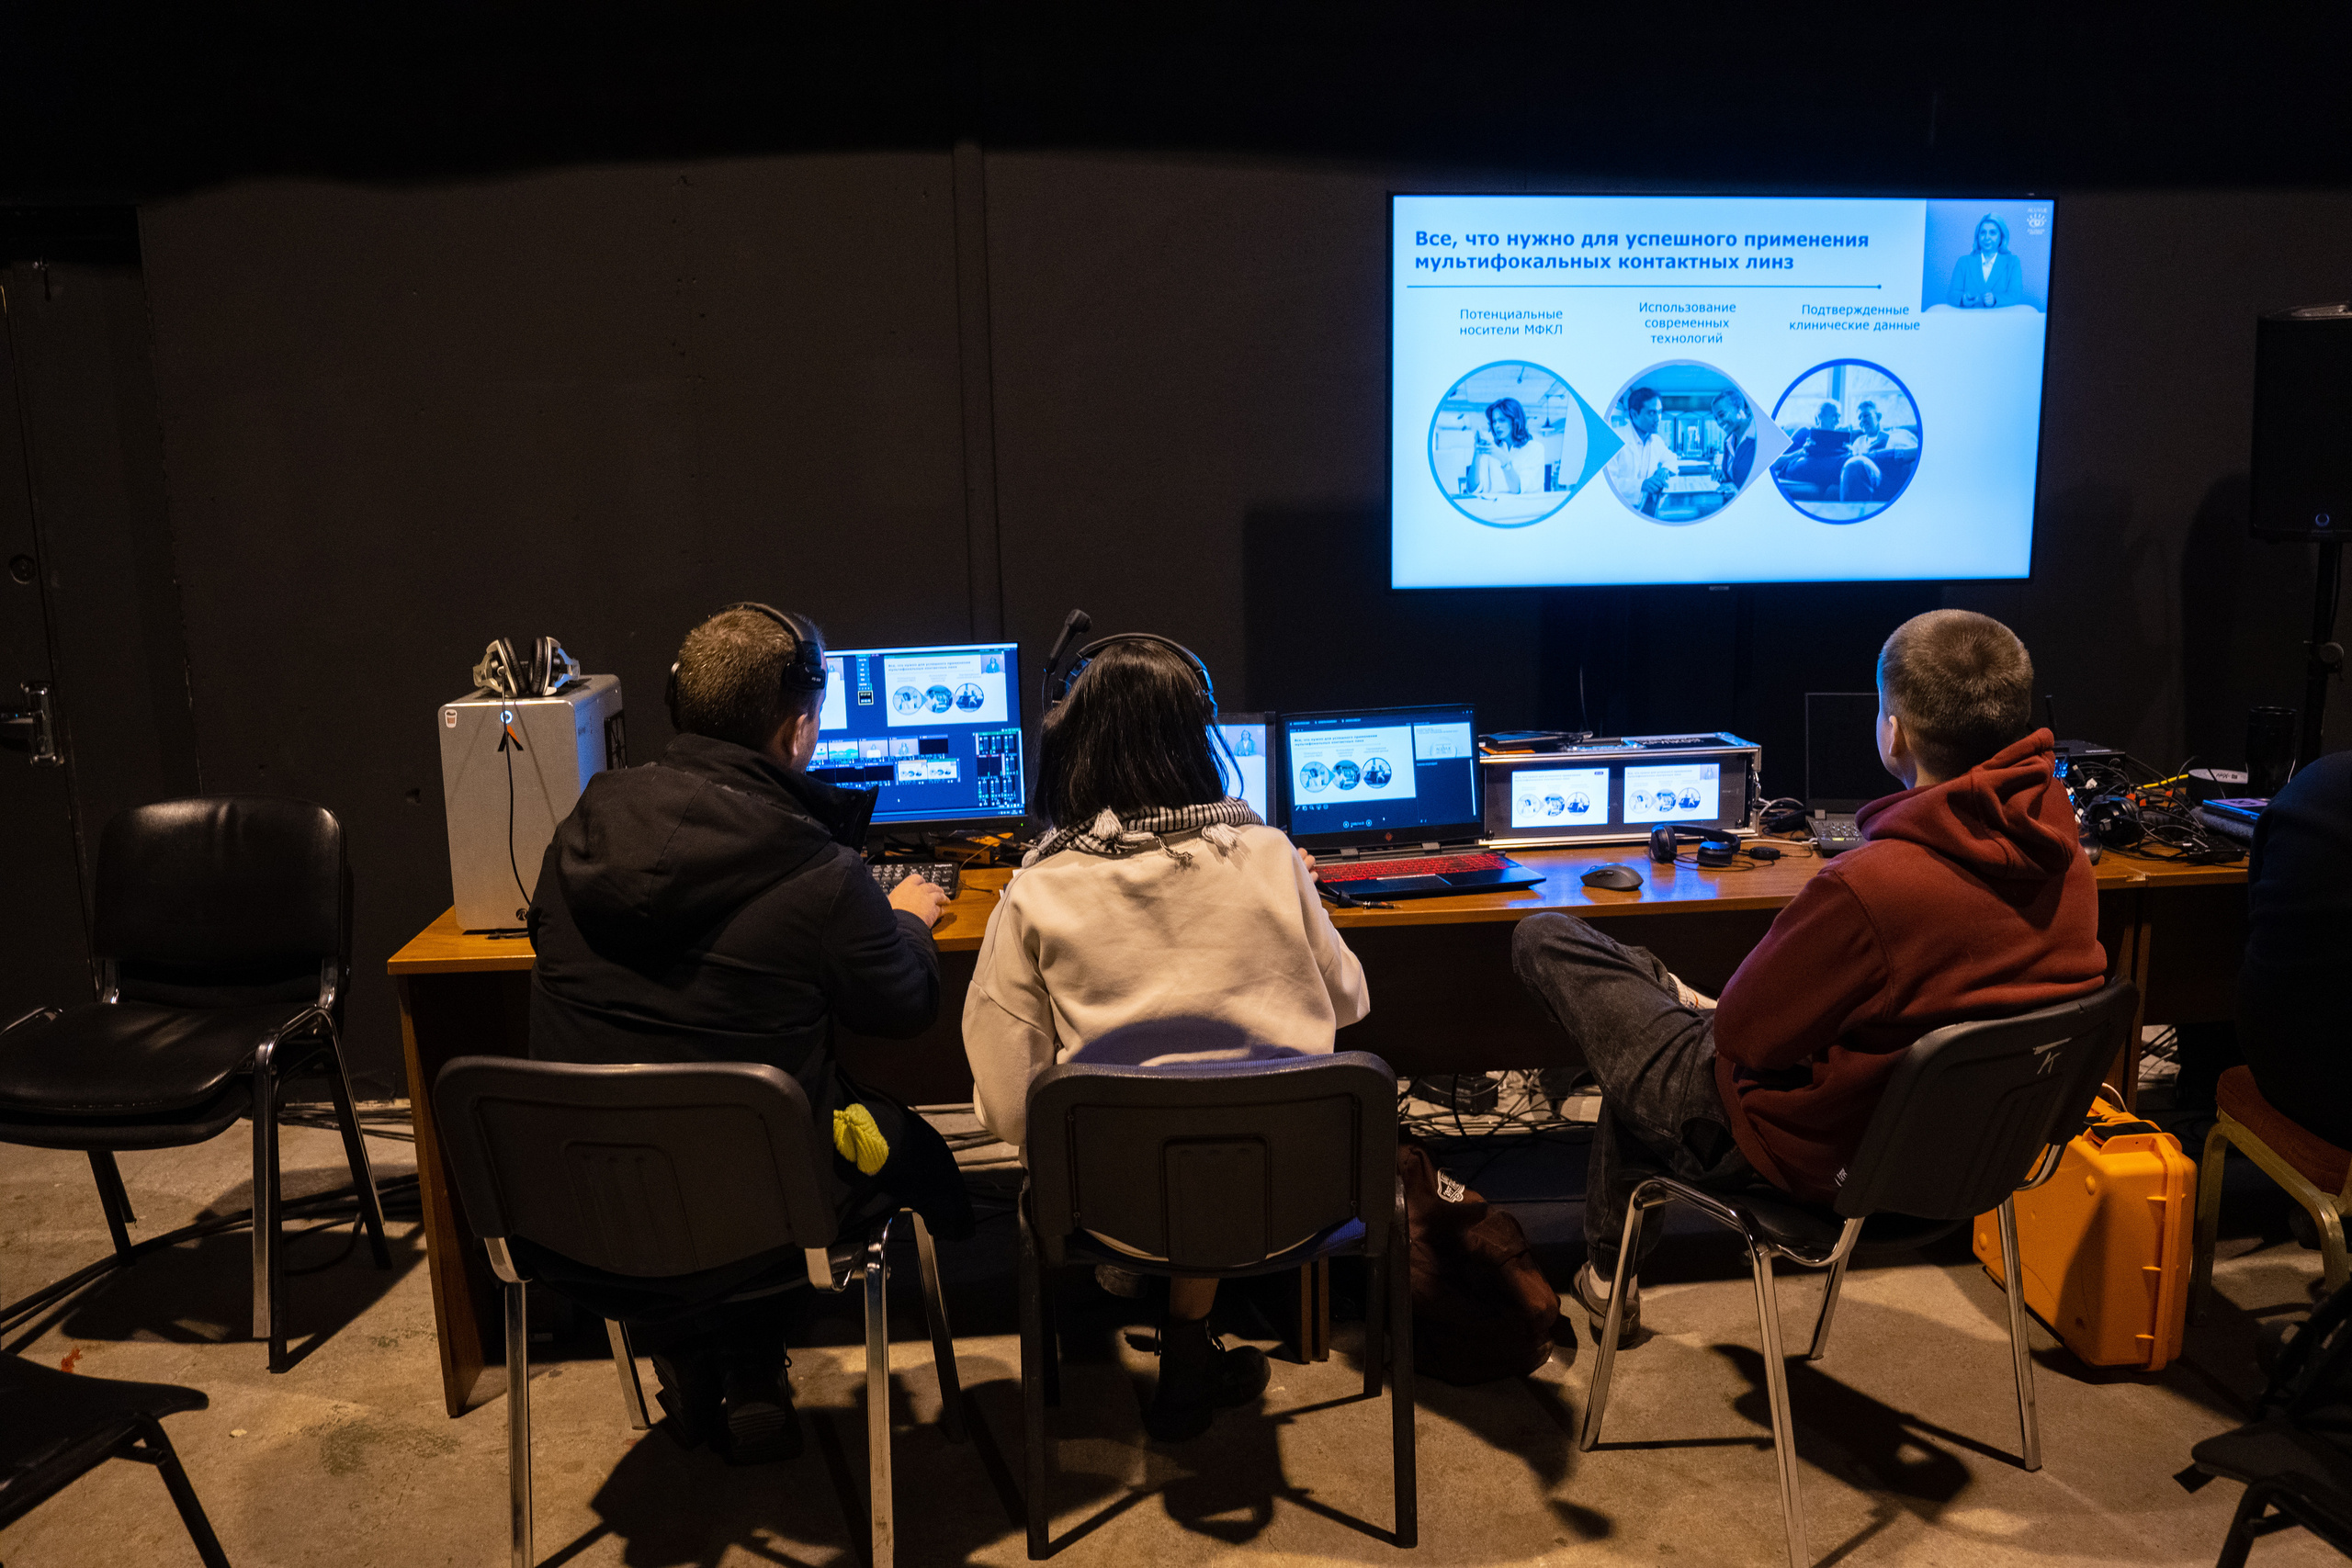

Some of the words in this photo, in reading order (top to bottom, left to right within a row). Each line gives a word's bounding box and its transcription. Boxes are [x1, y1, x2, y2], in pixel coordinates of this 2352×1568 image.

[1415, 230, 1458, 250] Все,
[1464, 232, 1500, 247] что
[1506, 232, 1576, 250] нужно
[1580, 233, 1619, 249] для
[1624, 233, 1738, 249] успешного
[1744, 233, 1870, 249] применения
[1415, 254, 1611, 273] мультифокальных
[1618, 255, 1740, 270] контактных
[1745, 256, 1794, 270] линз
[1639, 301, 1736, 313] Использование
[1801, 303, 1910, 318] Подтвержденные
[1460, 309, 1564, 321] Потенциальные
[1459, 326, 1520, 336] носители
[1524, 323, 1563, 335] МФКЛ
[1644, 319, 1730, 331] современных
[1789, 321, 1870, 331] клинические
[1872, 321, 1921, 333] данные
[1650, 333, 1723, 344] технологий
